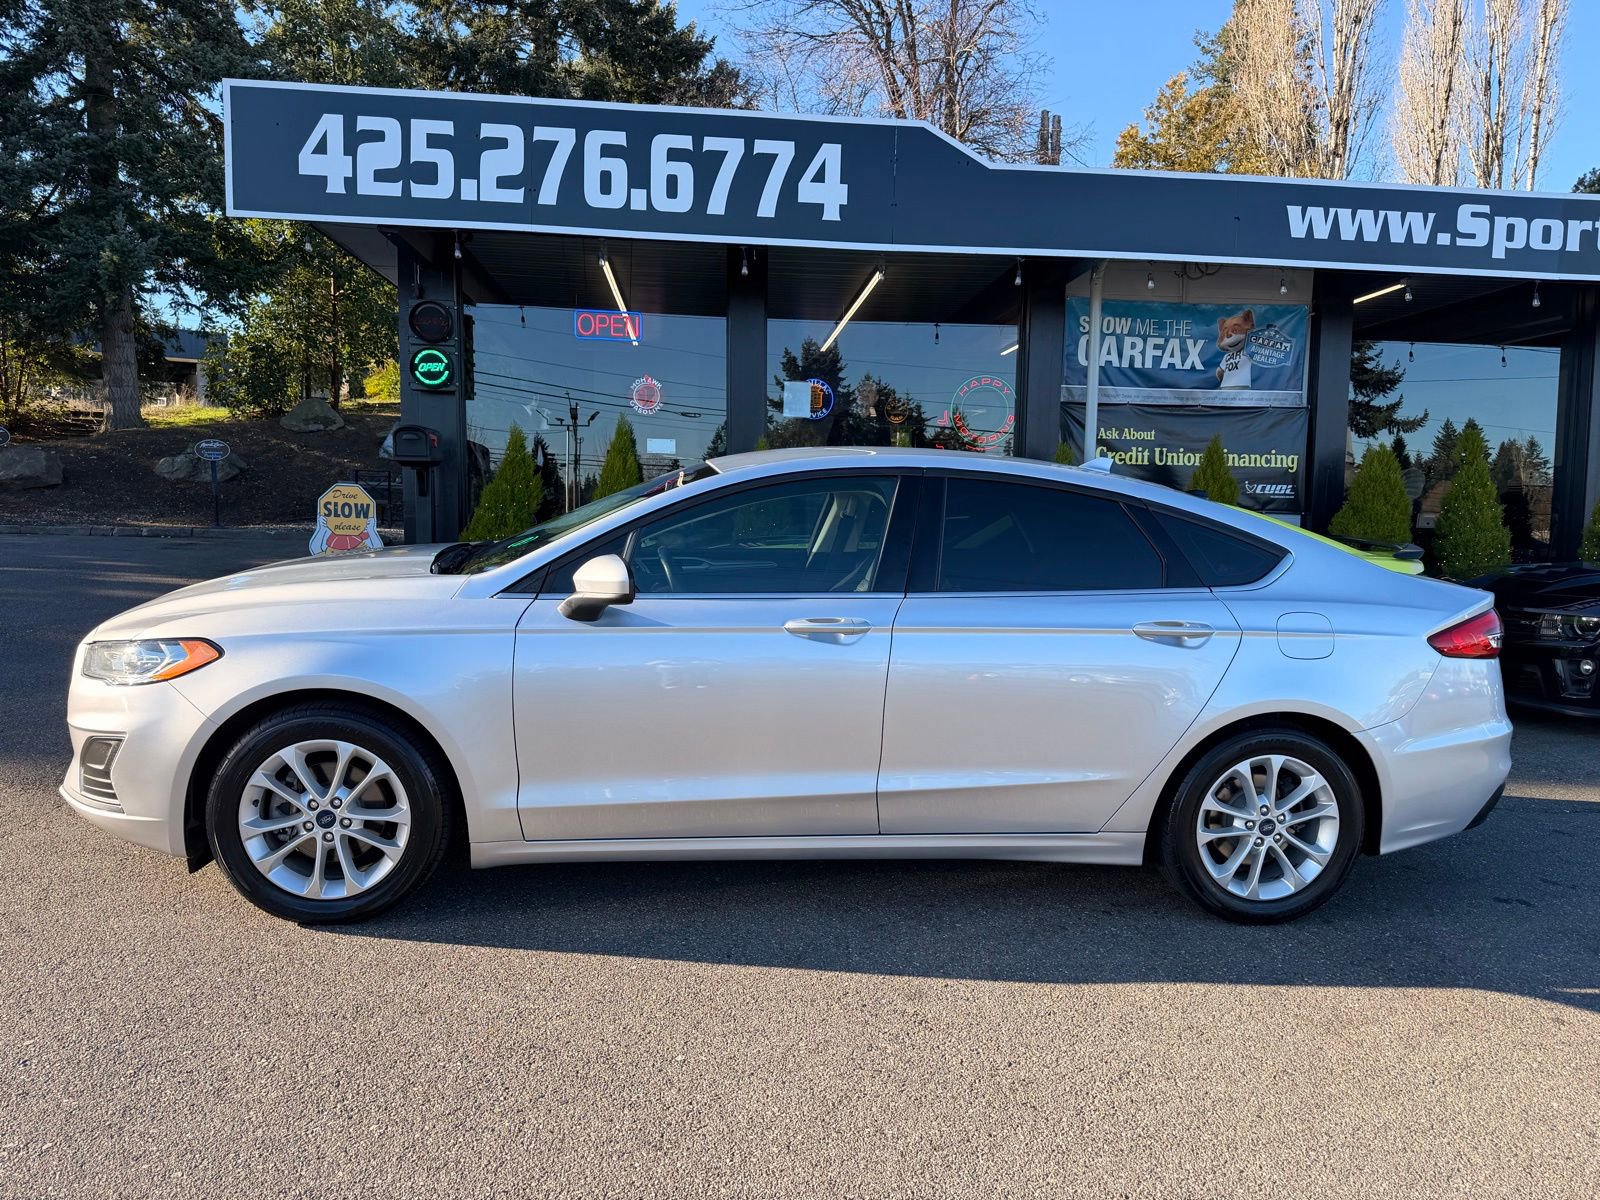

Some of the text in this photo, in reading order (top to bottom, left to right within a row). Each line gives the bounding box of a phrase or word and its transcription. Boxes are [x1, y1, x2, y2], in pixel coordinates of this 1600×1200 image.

[298, 113, 849, 221] 425.276.6774
[1286, 203, 1600, 259] www.Spor
[577, 313, 639, 337] OPEN
[1079, 315, 1192, 337] SOW ME THE
[1250, 335, 1292, 351] CARFAX
[1250, 345, 1286, 359] ADVANTAGE
[1252, 353, 1278, 365] DEALER
[418, 363, 446, 372] OPEN
[1225, 361, 1240, 372] FOX
[630, 377, 663, 390] MOHAWK
[959, 377, 1011, 397] HAPPY
[630, 400, 664, 415] GASOLINE
[1098, 428, 1155, 440] Ask About
[1223, 449, 1299, 473] inancing
[332, 489, 358, 499] Drive
[323, 501, 370, 519] SLOW
[333, 522, 361, 531] please
